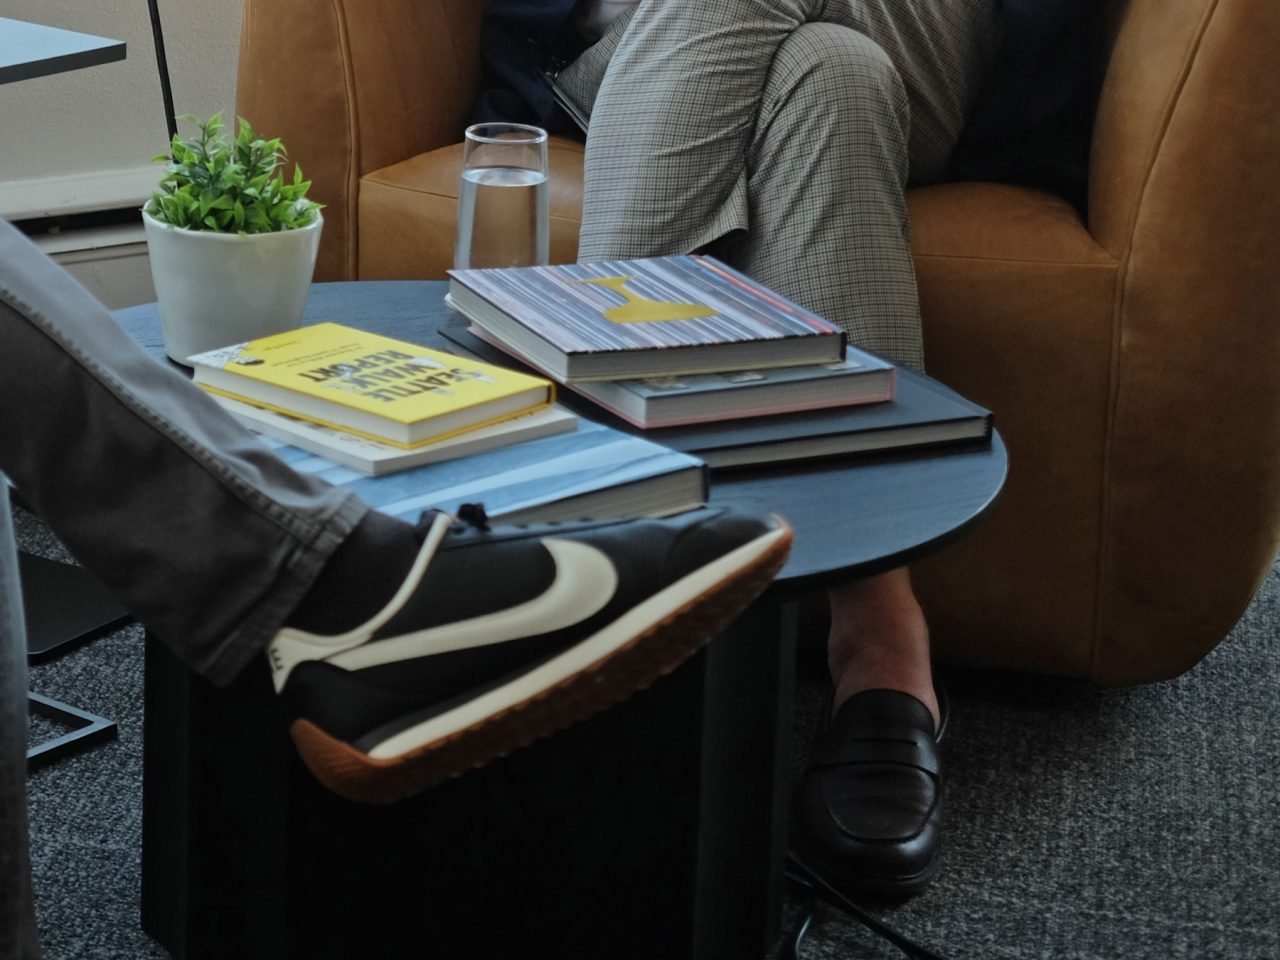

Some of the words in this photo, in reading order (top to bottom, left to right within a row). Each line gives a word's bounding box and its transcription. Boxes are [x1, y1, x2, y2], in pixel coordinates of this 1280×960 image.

[297, 349, 415, 383] REPORT
[341, 363, 438, 389] WALK
[362, 368, 466, 402] SEATTLE
